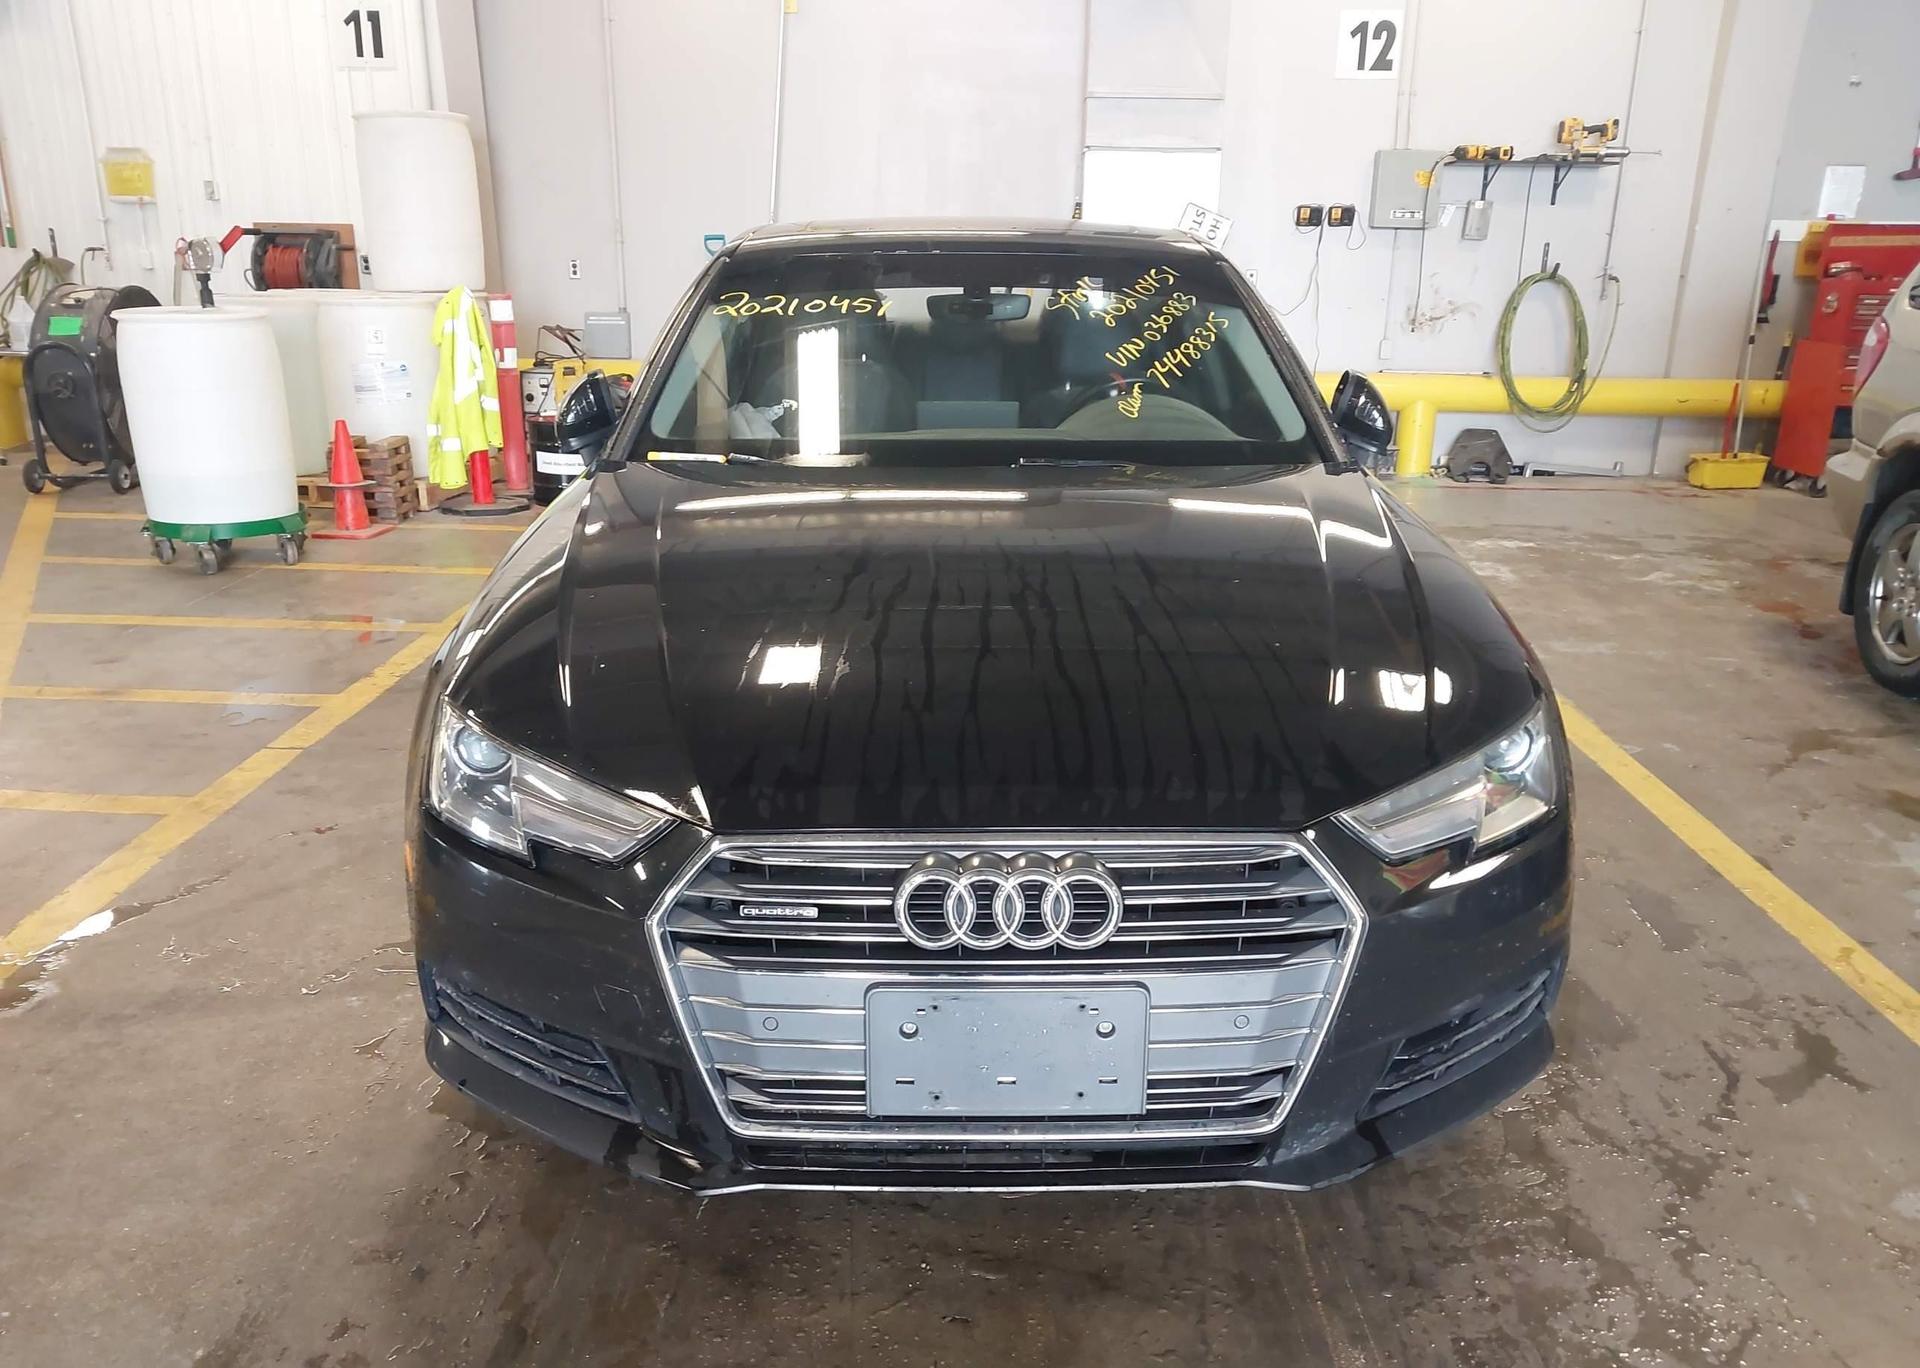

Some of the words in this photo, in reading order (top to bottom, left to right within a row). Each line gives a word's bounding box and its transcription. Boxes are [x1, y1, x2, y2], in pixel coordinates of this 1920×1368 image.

[343, 9, 384, 59] 11
[1350, 19, 1397, 71] 12
[1206, 218, 1223, 241] HO
[712, 291, 893, 317] 20210451
[1089, 265, 1181, 328] 20210451
[1105, 337, 1145, 367] VIN
[1143, 292, 1196, 341] 036883
[1146, 311, 1229, 389] 74488315
[743, 907, 815, 917] quattro
